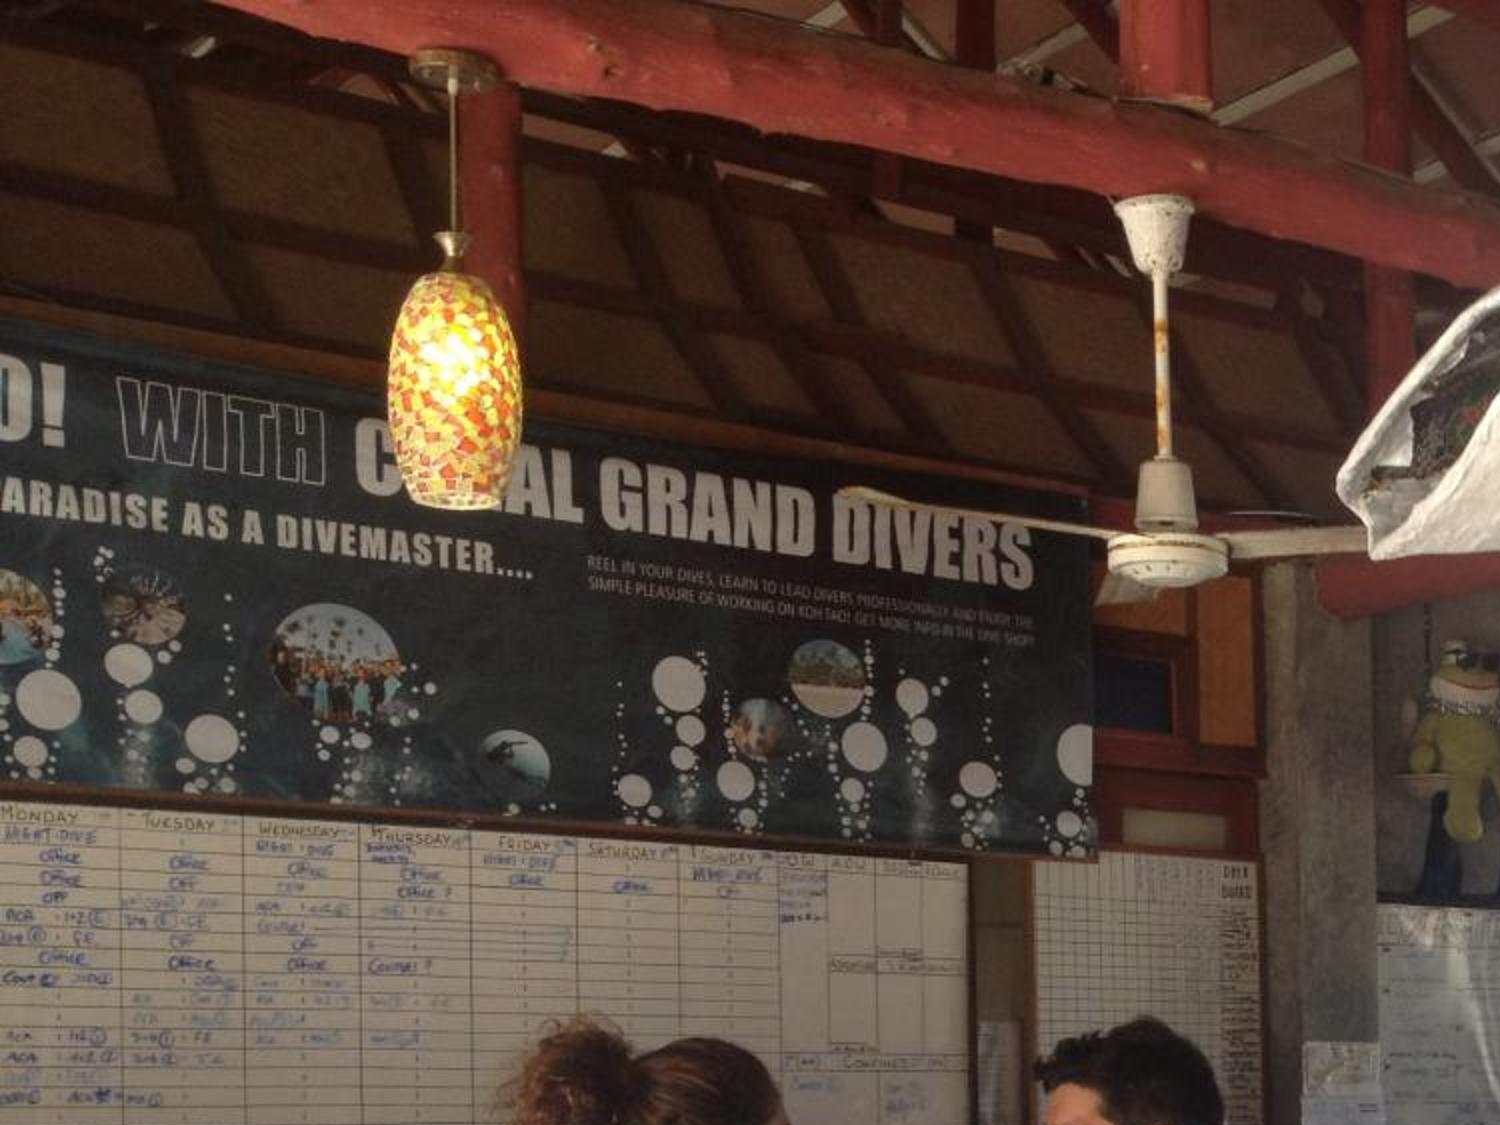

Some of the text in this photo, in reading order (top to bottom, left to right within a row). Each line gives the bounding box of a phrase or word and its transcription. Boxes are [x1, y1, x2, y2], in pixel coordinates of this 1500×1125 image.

[115, 376, 327, 486] WITH
[355, 417, 584, 524] CAL
[600, 457, 816, 559] GRAND
[832, 487, 1035, 592] DIVERS
[0, 476, 169, 532] ARADISE
[181, 501, 229, 541] AS
[242, 510, 265, 547] A
[588, 576, 632, 595] SIMPLE
[635, 582, 696, 602] PLEASURE
[699, 591, 714, 605] OF
[717, 593, 775, 613] WORKING
[778, 602, 795, 617] ON
[799, 605, 823, 620] KOH
[621, 560, 636, 576] IN
[640, 563, 673, 581] YOUR
[719, 575, 759, 592] LEARN
[762, 580, 778, 595] TO
[781, 582, 812, 599] LEAD
[1, 804, 79, 824] MONDAY
[143, 814, 215, 831] TUESDAY
